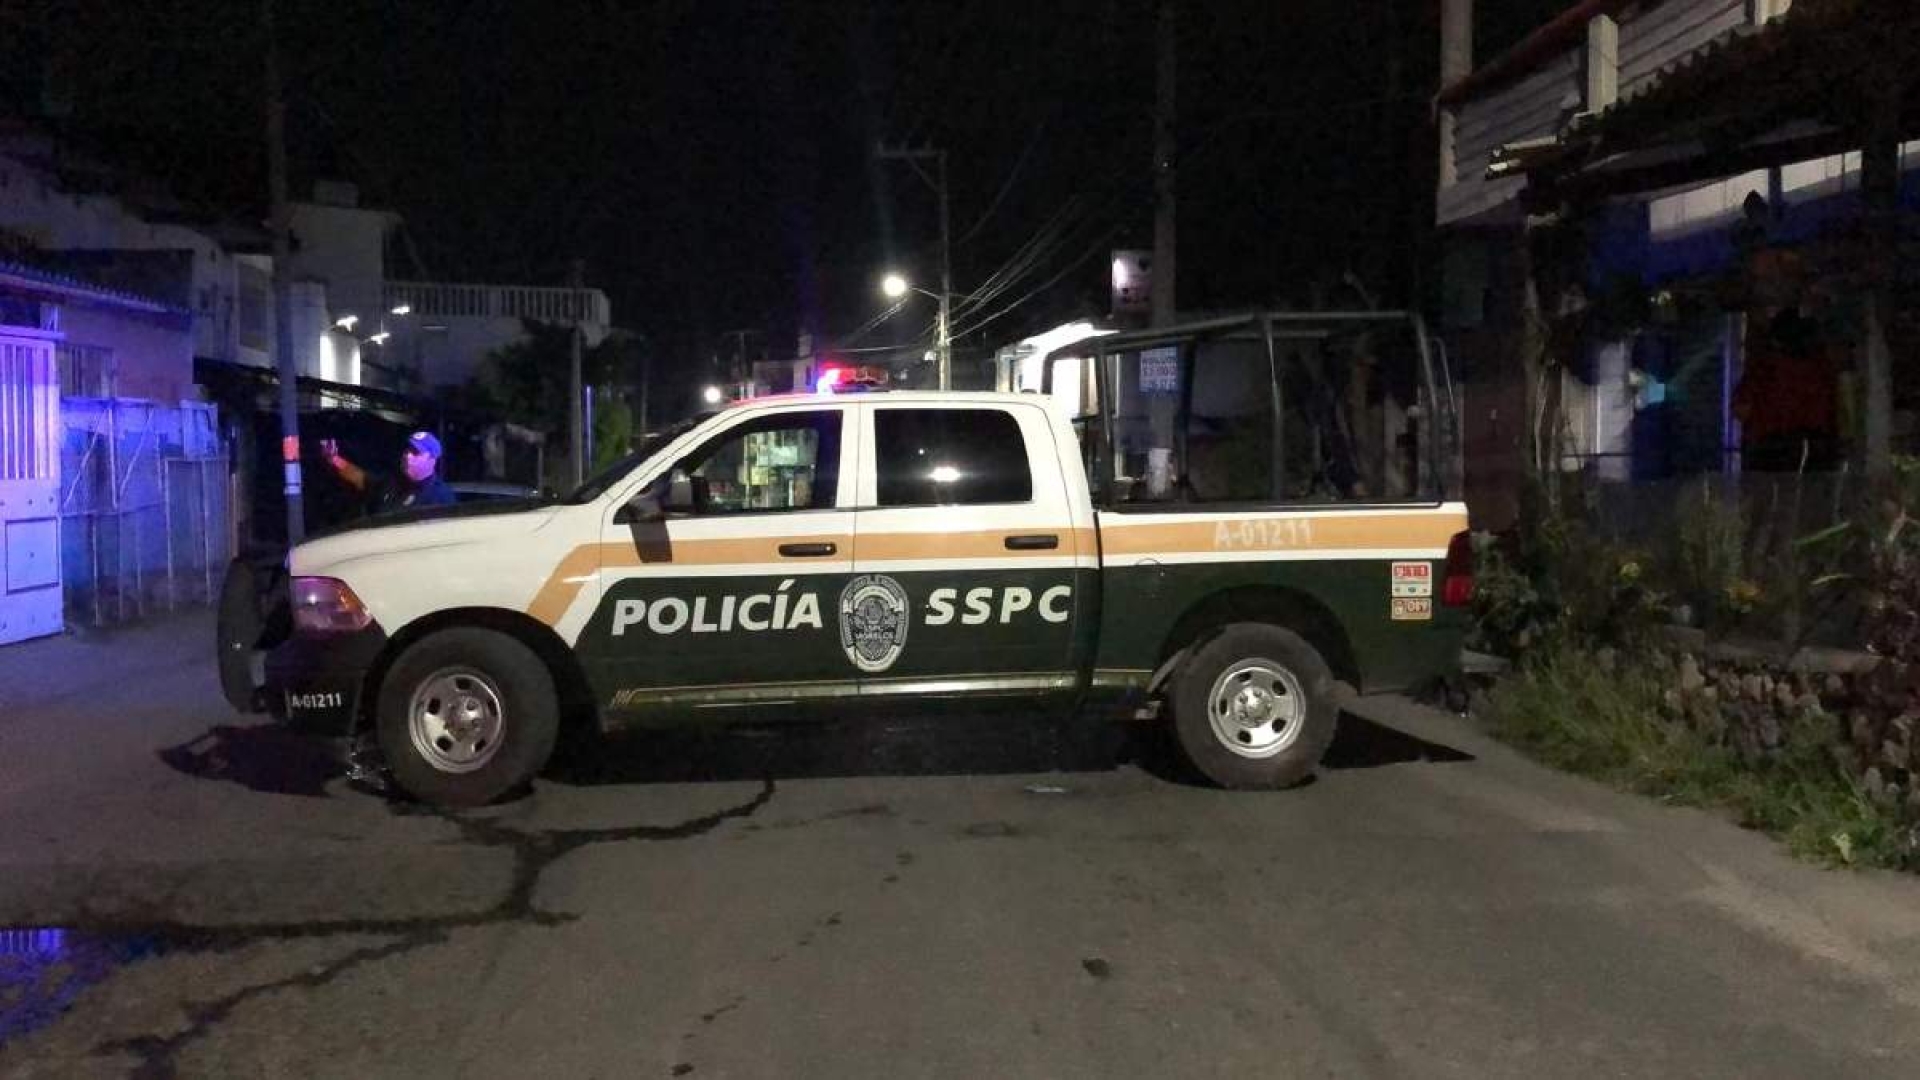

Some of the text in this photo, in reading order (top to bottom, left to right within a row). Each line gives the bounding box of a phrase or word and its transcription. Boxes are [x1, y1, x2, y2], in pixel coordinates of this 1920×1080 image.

[1213, 518, 1311, 548] A-01211
[611, 579, 823, 636] POLICÍA
[925, 586, 1072, 625] SSPC
[292, 692, 341, 708] A-01211
